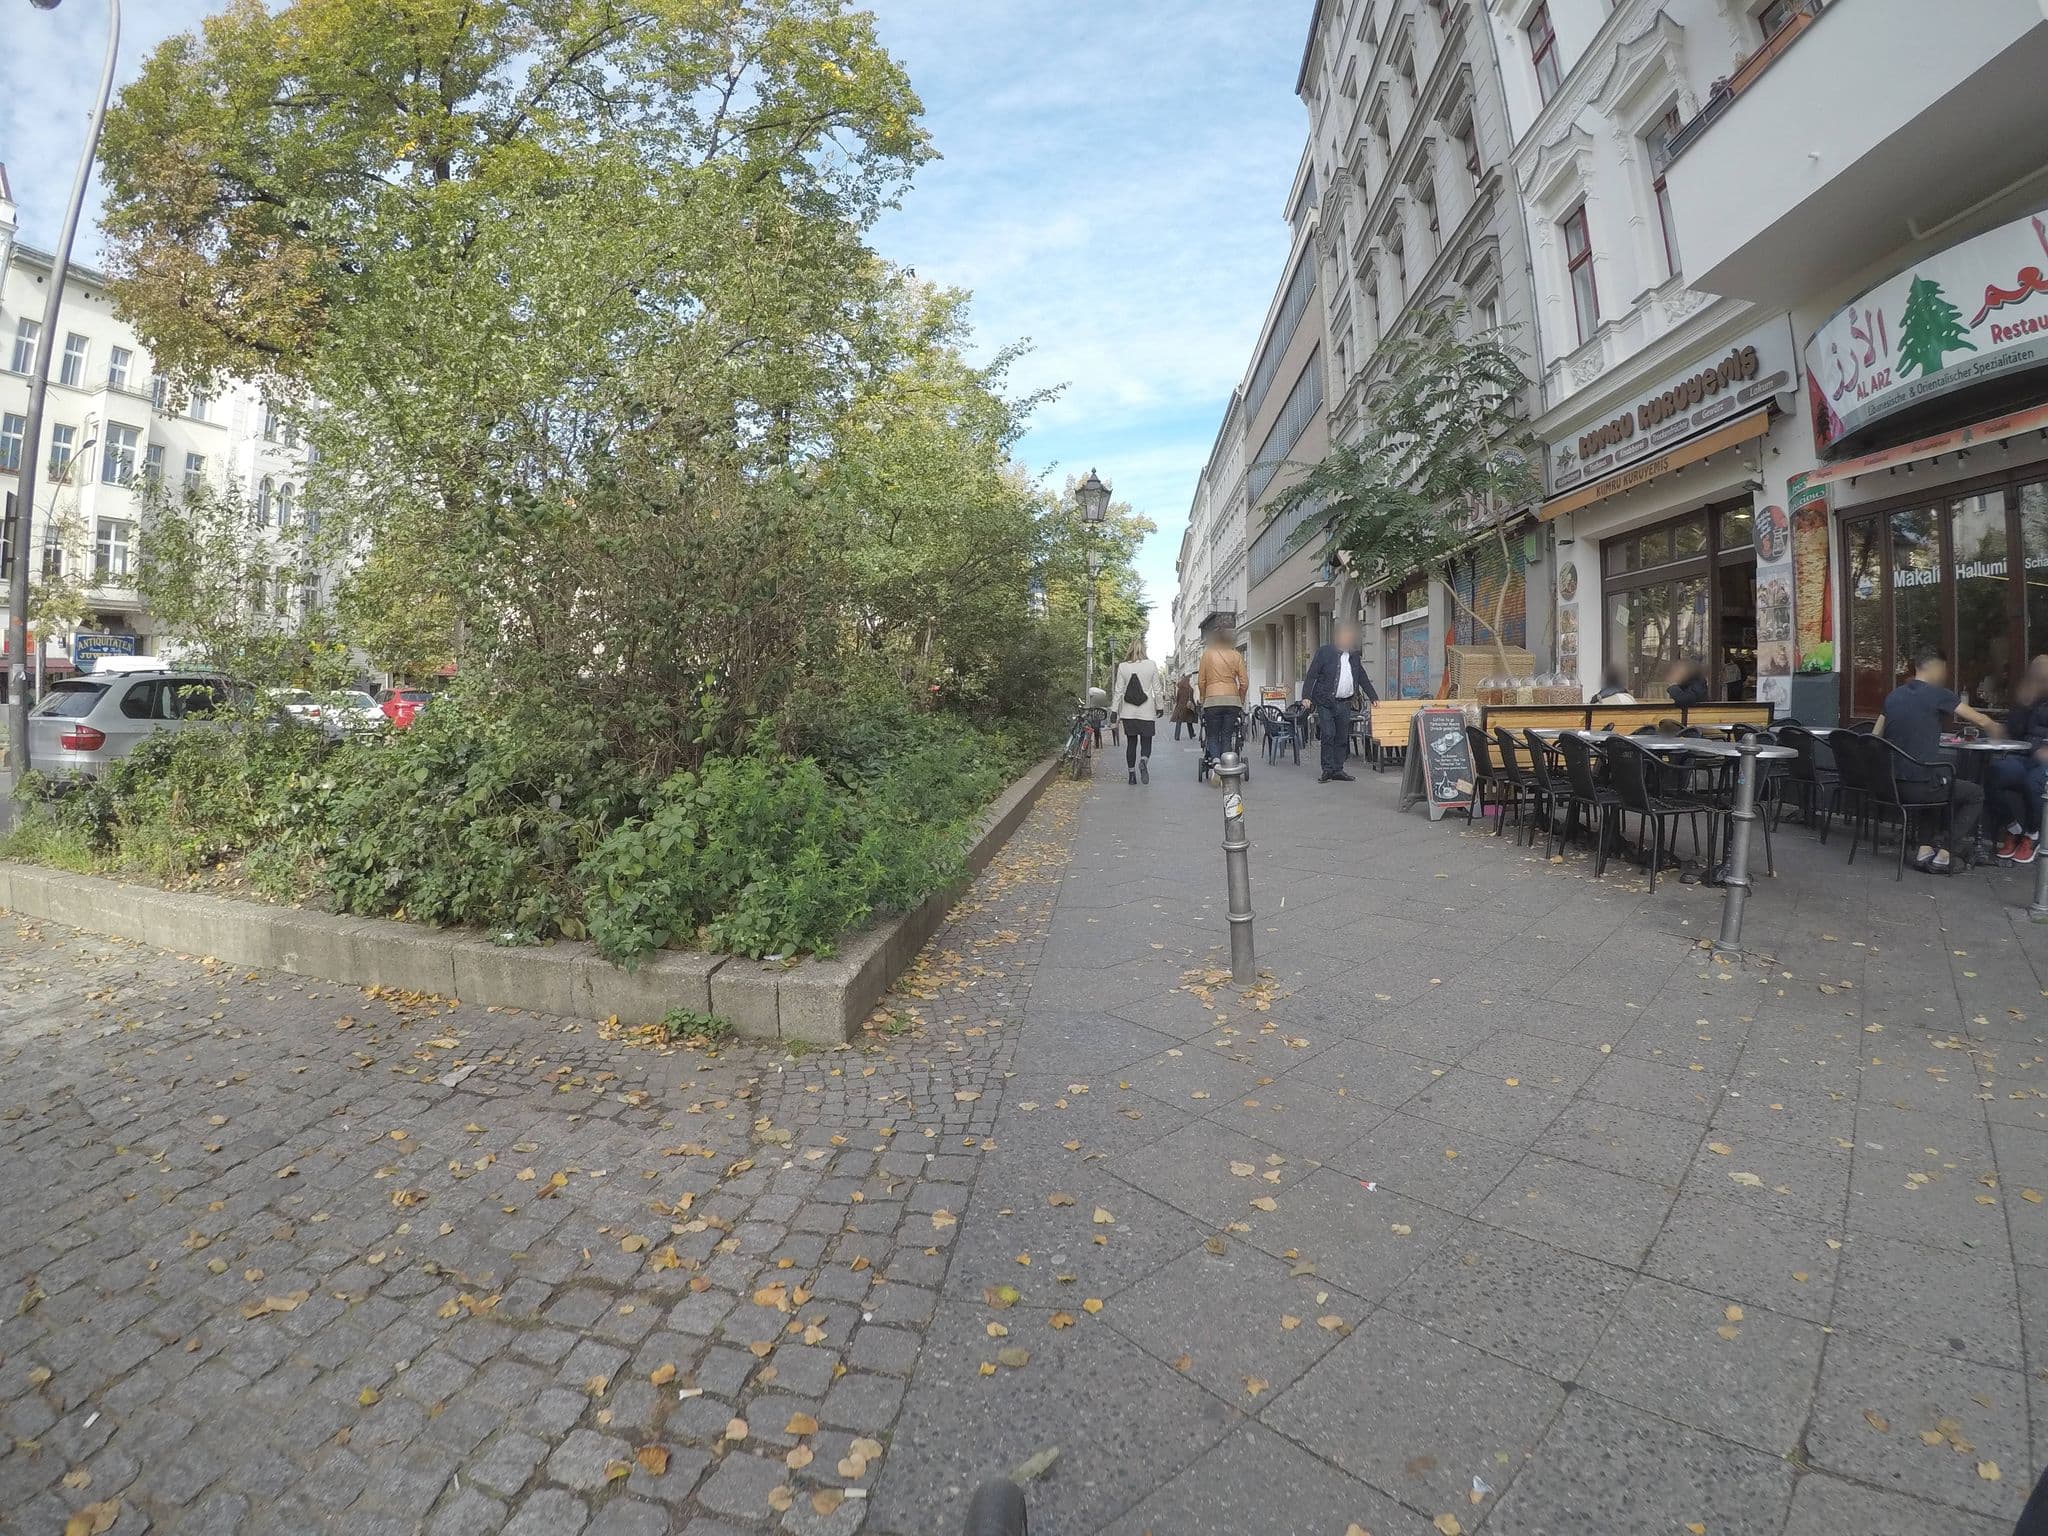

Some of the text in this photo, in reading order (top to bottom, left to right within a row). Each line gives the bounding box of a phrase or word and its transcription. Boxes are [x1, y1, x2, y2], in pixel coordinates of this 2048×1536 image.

[1990, 314, 2048, 344] Restau
[1751, 379, 1774, 396] Lokum
[1856, 368, 1892, 401] AL ARZ
[1909, 386, 1915, 398] &
[1917, 367, 1972, 394] Orientalischer
[1973, 349, 2034, 376] Spezialitäten
[1596, 475, 1621, 497] KUMRU
[1893, 565, 1940, 588] Makali
[1955, 558, 2007, 580] Hallumi
